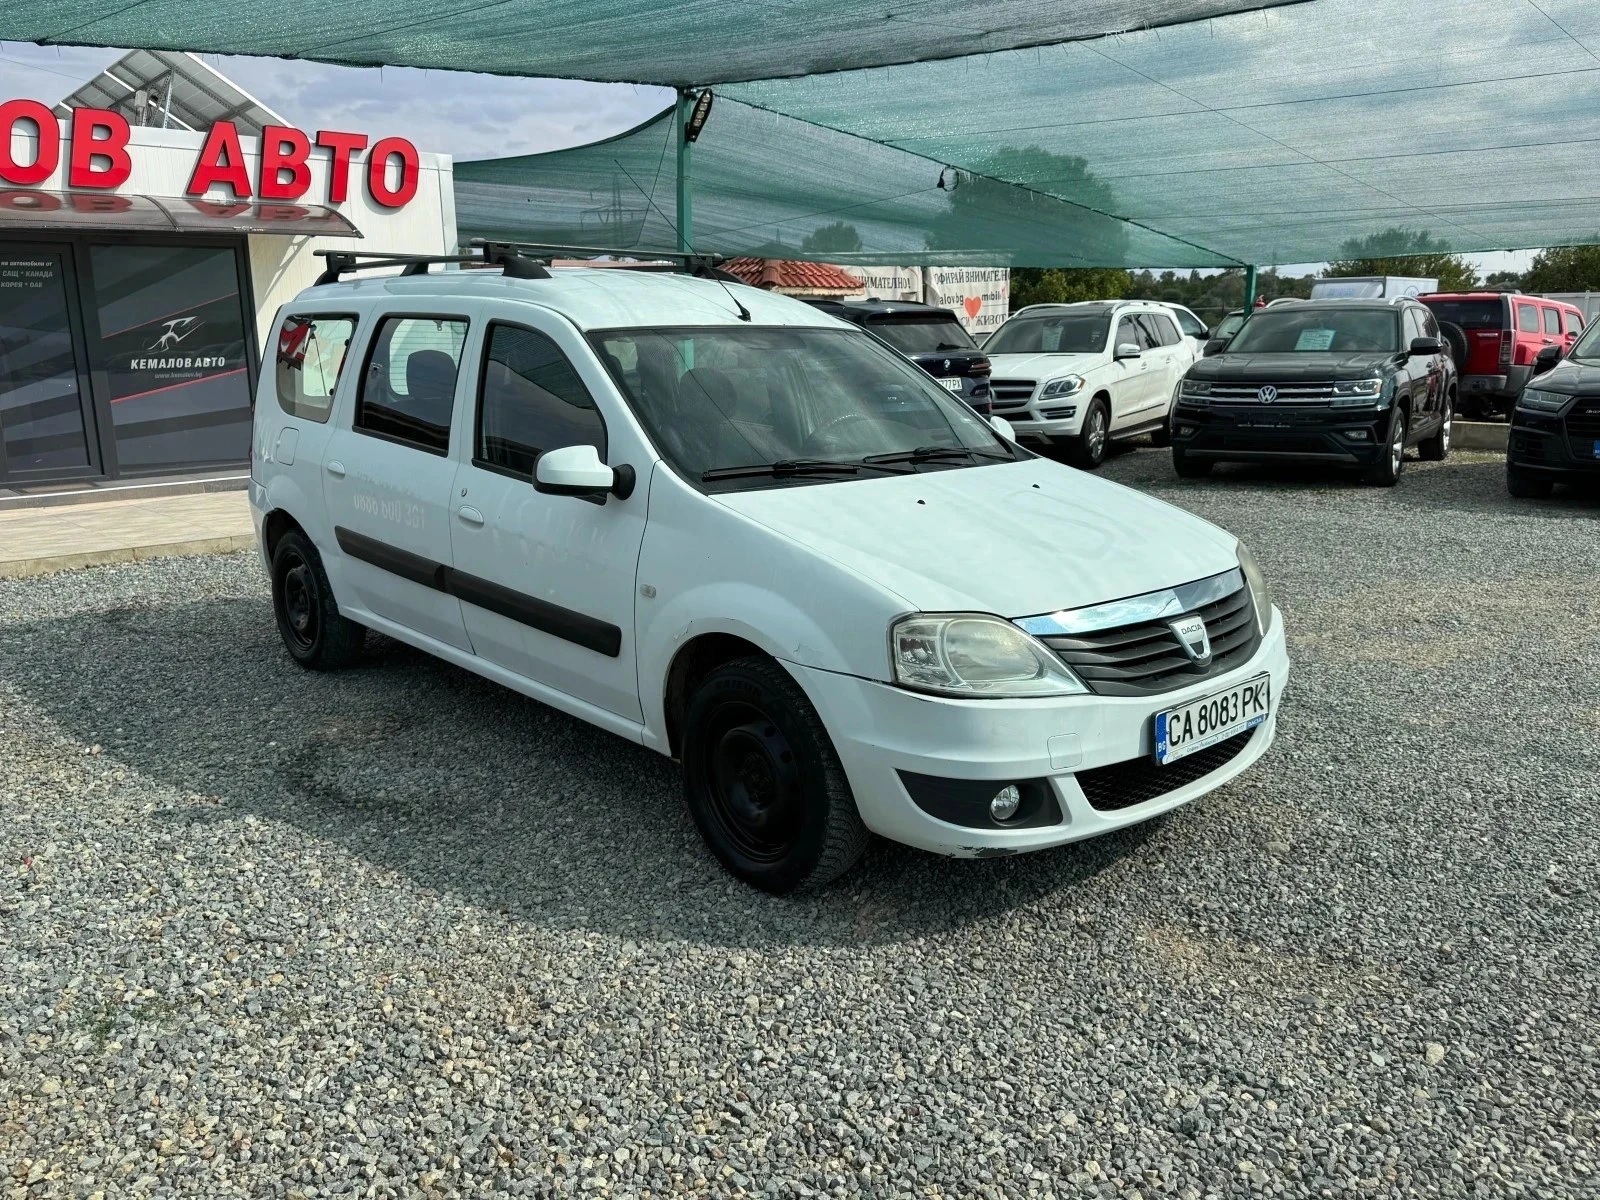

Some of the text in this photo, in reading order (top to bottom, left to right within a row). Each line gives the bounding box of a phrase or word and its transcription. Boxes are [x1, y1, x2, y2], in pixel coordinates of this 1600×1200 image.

[0, 99, 420, 208] ОВ АВТО
[2, 270, 53, 278] САЩ КАНАДА
[130, 356, 226, 370] КЕМАЛОВ АВТО
[1180, 624, 1203, 635] DACIA
[1158, 740, 1167, 753] BG
[1169, 710, 1194, 747] CA
[1198, 692, 1238, 735] 8083
[1242, 682, 1265, 717] PK
